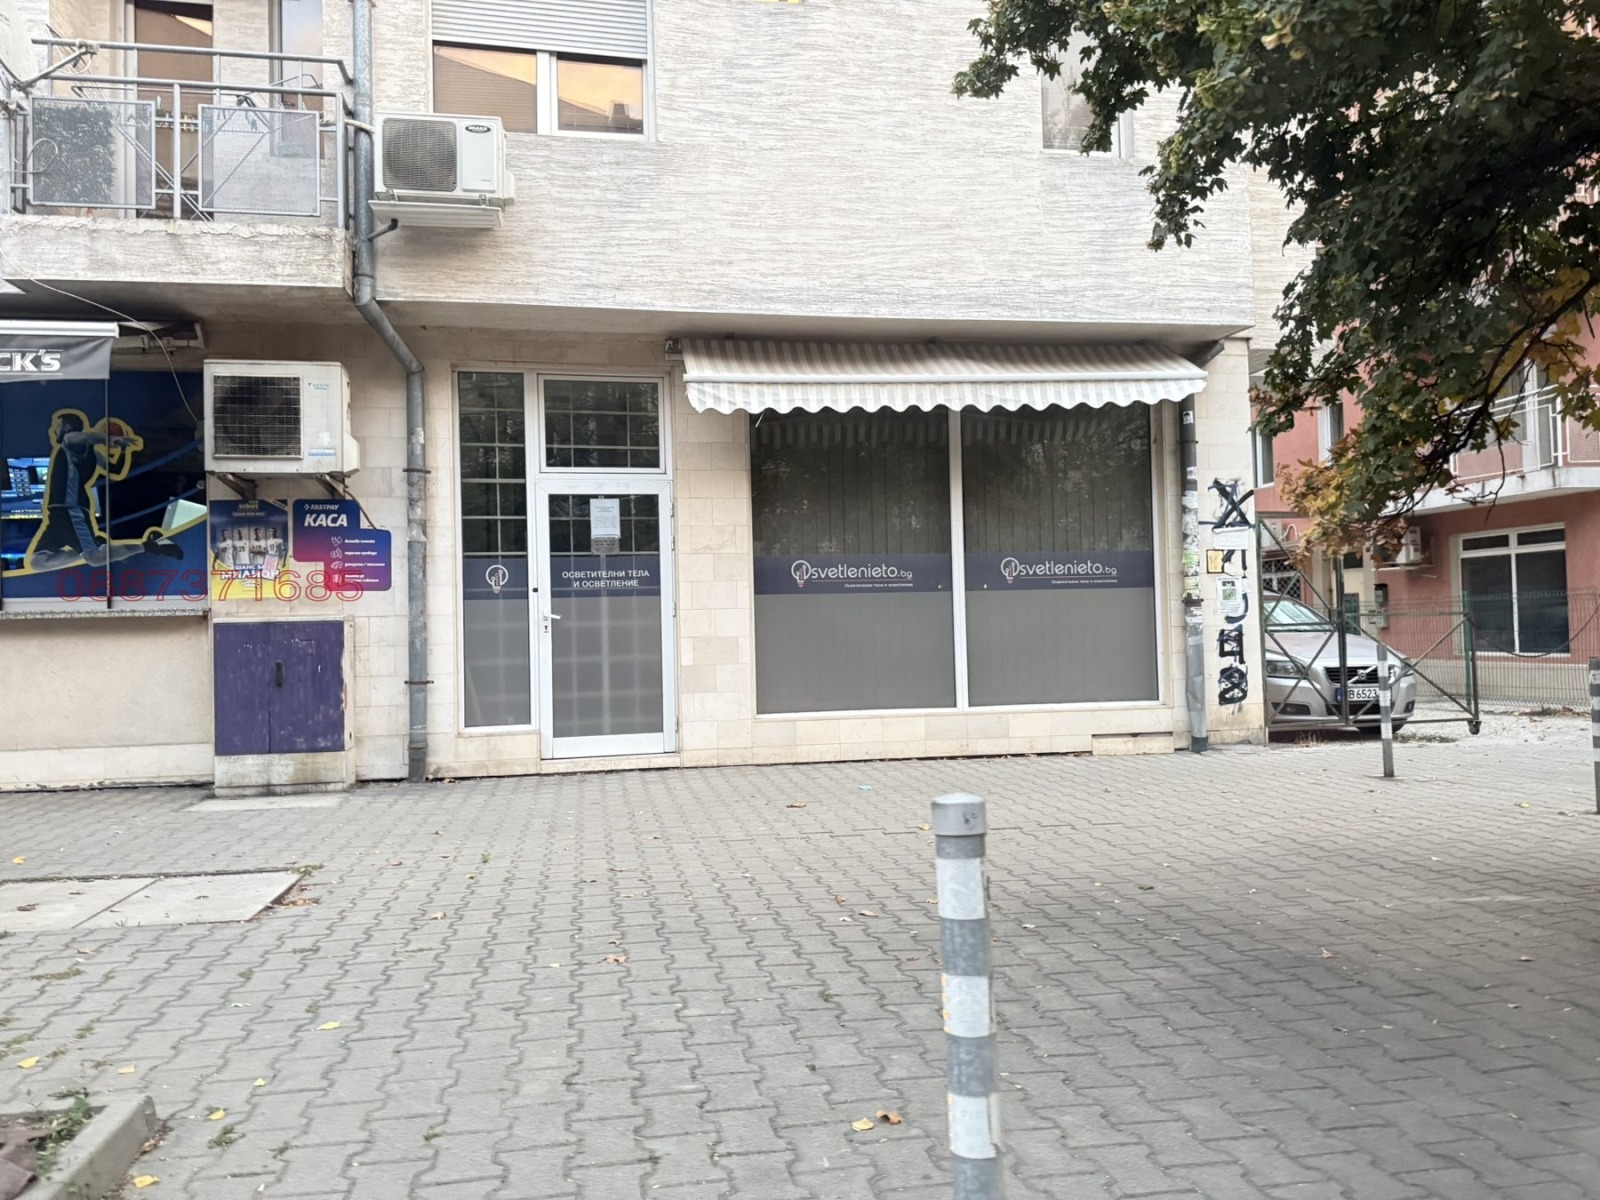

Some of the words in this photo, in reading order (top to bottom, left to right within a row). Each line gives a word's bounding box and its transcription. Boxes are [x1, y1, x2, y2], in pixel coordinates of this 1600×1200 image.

[304, 513, 348, 527] КАСА
[562, 570, 625, 578] ОСВЕТИТЕЛНИ
[573, 580, 580, 588] И
[581, 580, 639, 588] ОСВЕТЛЕНИЕ
[1356, 689, 1378, 699] 6523
